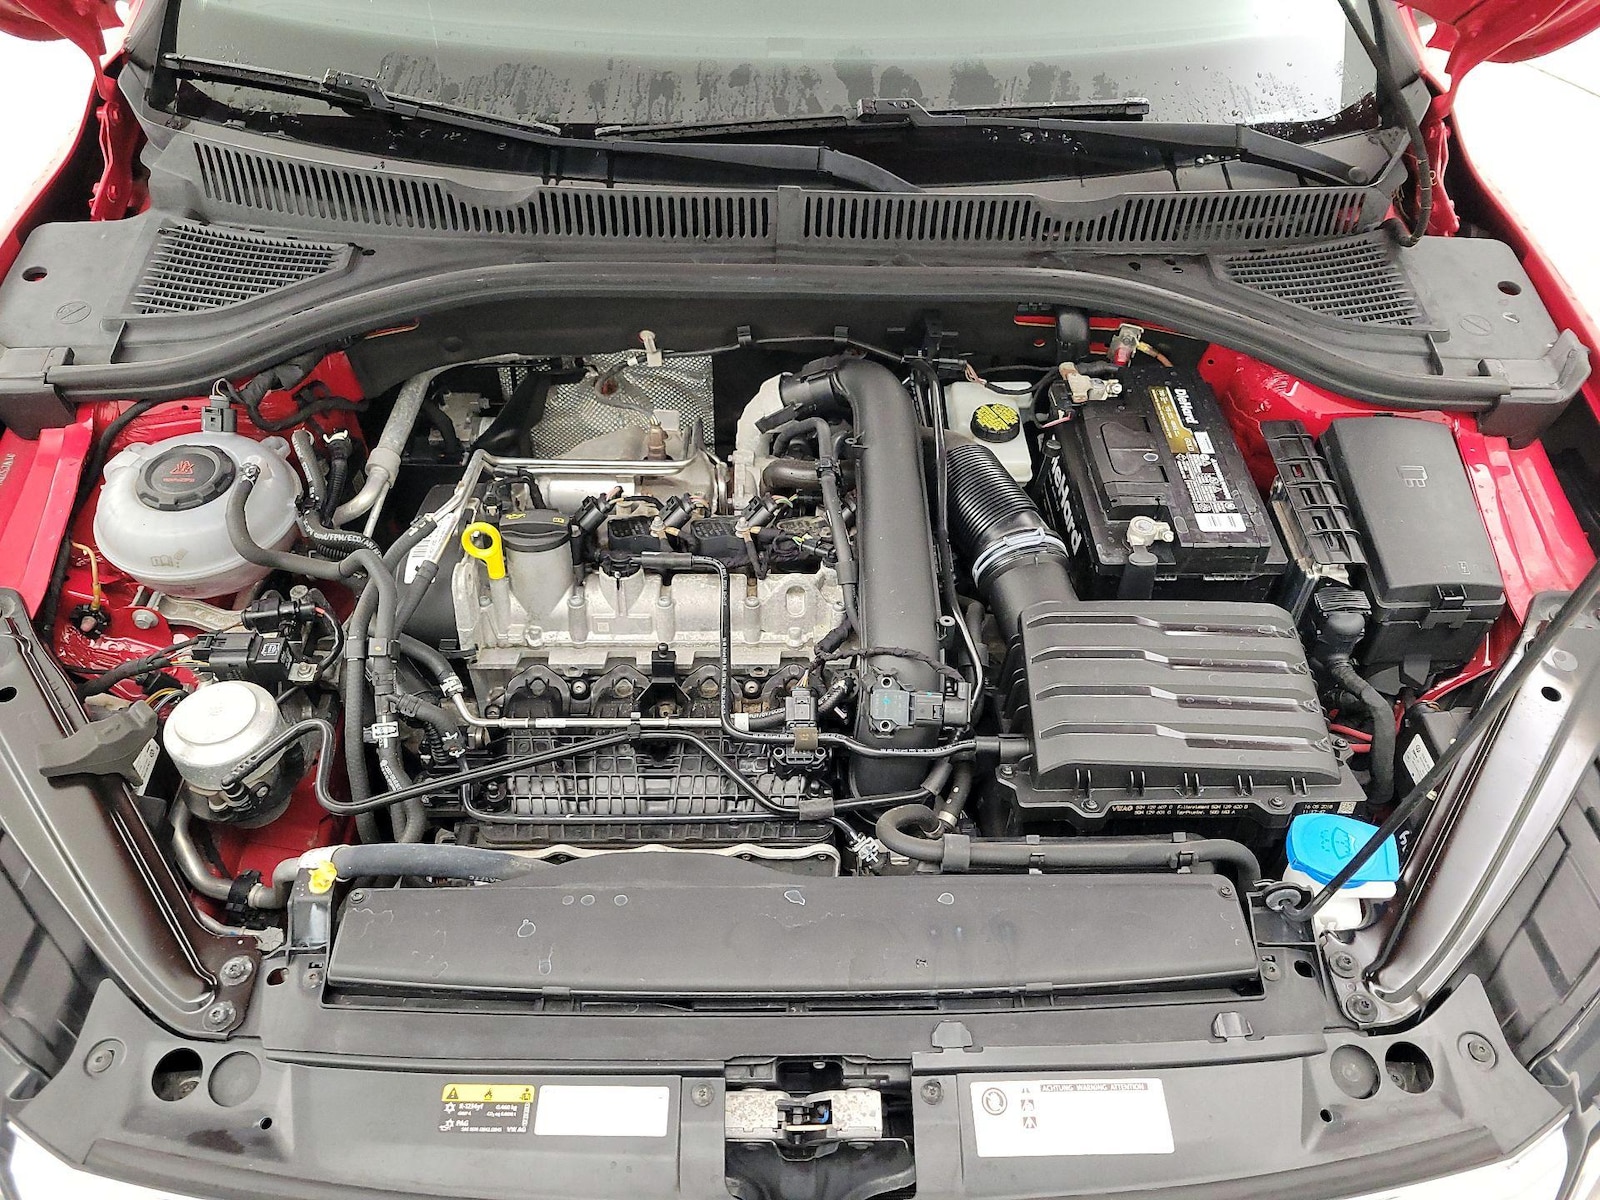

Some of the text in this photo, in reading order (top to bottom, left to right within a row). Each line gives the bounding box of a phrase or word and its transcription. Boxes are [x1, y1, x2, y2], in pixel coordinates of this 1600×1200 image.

[1174, 388, 1199, 424] DieHard
[1184, 437, 1195, 452] GOLD
[1050, 455, 1082, 556] ieHard
[1042, 1084, 1074, 1092] ACHTUNG
[1110, 1083, 1145, 1091] ATTENTION
